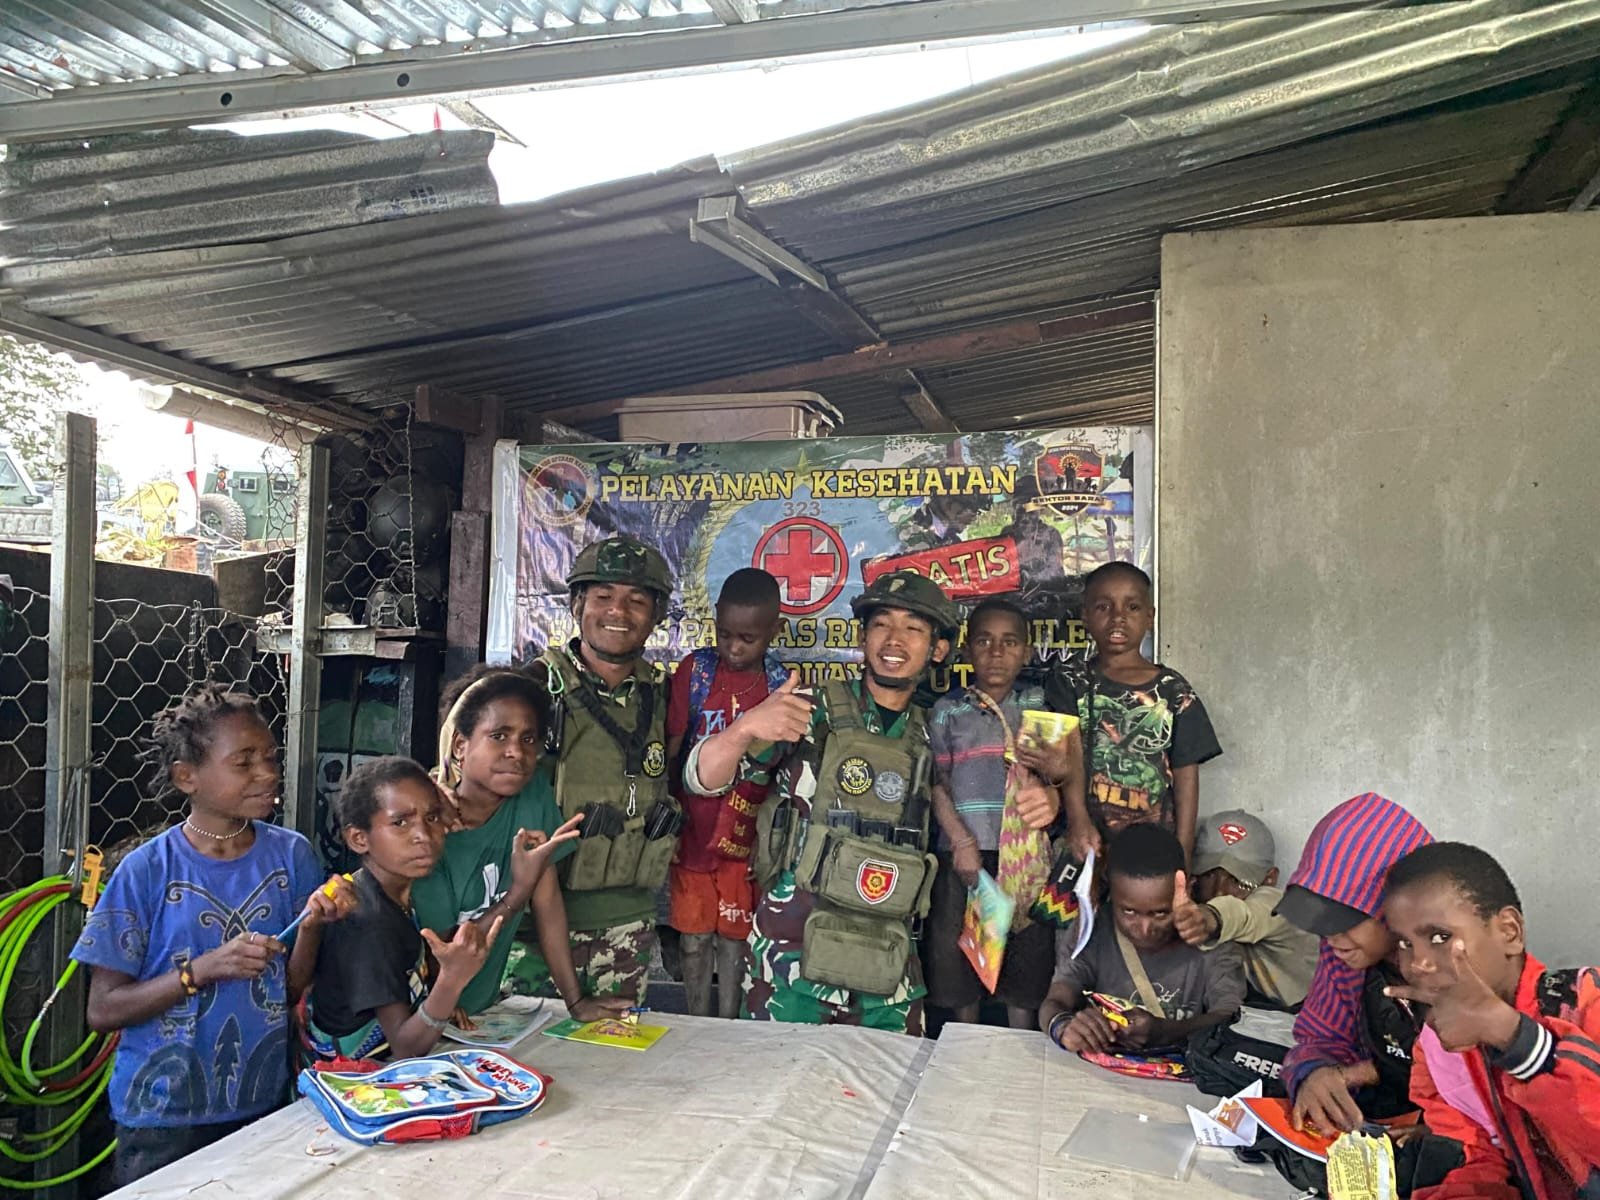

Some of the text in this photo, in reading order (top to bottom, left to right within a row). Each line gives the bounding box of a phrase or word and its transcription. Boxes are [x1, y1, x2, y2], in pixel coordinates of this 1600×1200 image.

[600, 464, 1018, 502] PELAYANAN KESEHATAN
[783, 502, 821, 516] 323
[900, 545, 1011, 589] ATIS
